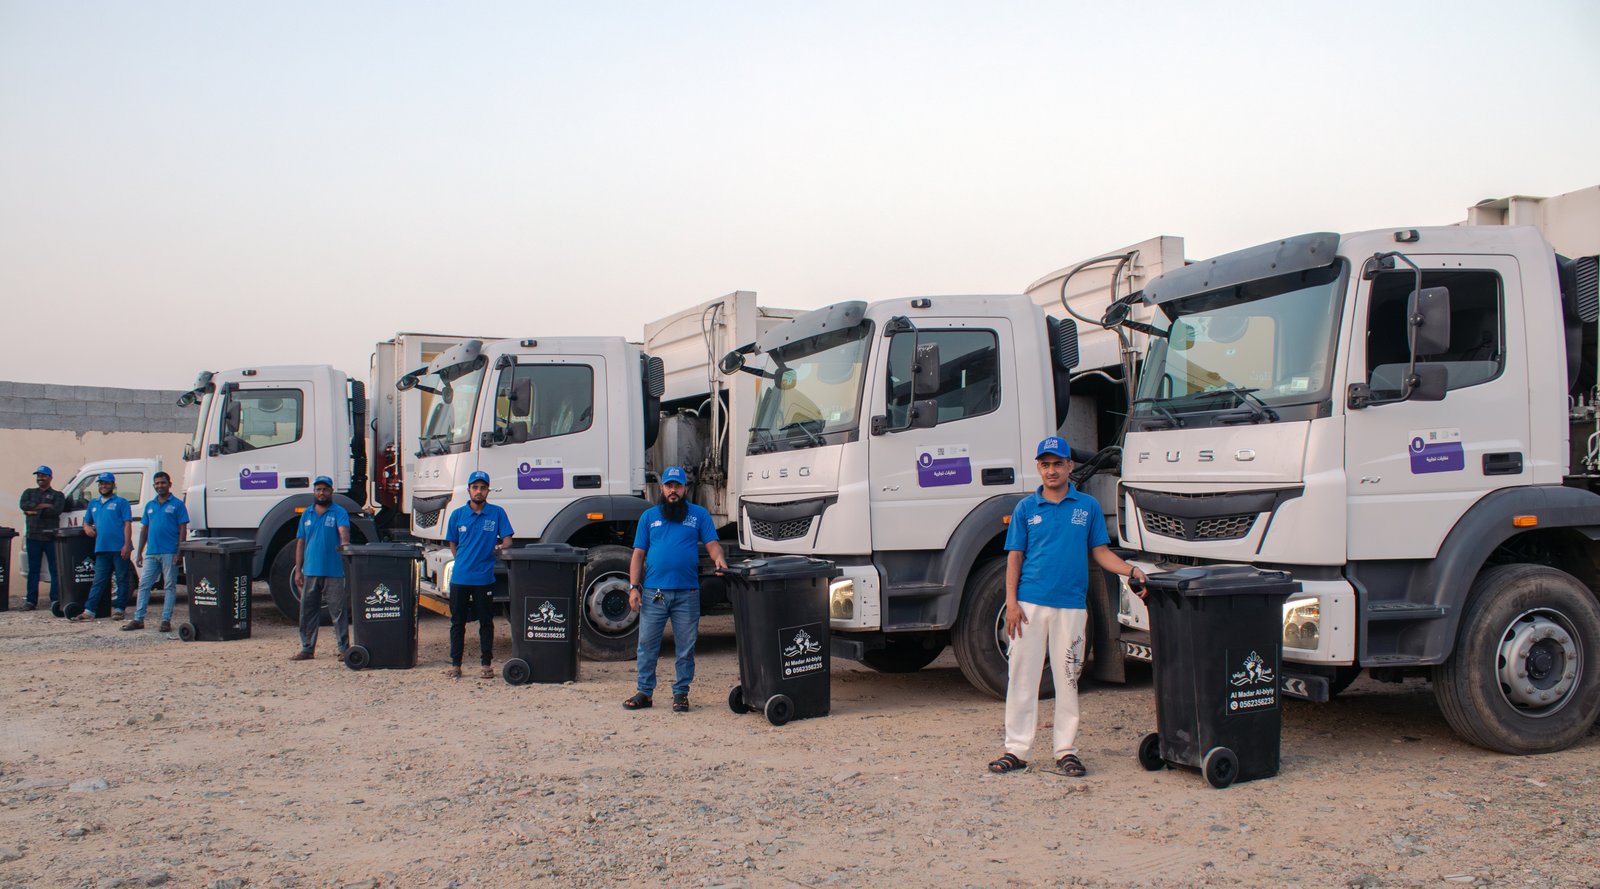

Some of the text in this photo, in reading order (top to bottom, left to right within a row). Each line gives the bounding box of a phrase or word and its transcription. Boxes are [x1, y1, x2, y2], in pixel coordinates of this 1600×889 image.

[1138, 449, 1256, 463] FUSO
[746, 467, 810, 481] FUSO
[792, 662, 823, 673] 0562356235
[1238, 690, 1256, 698] Madar
[1239, 697, 1275, 708] 0562356235
